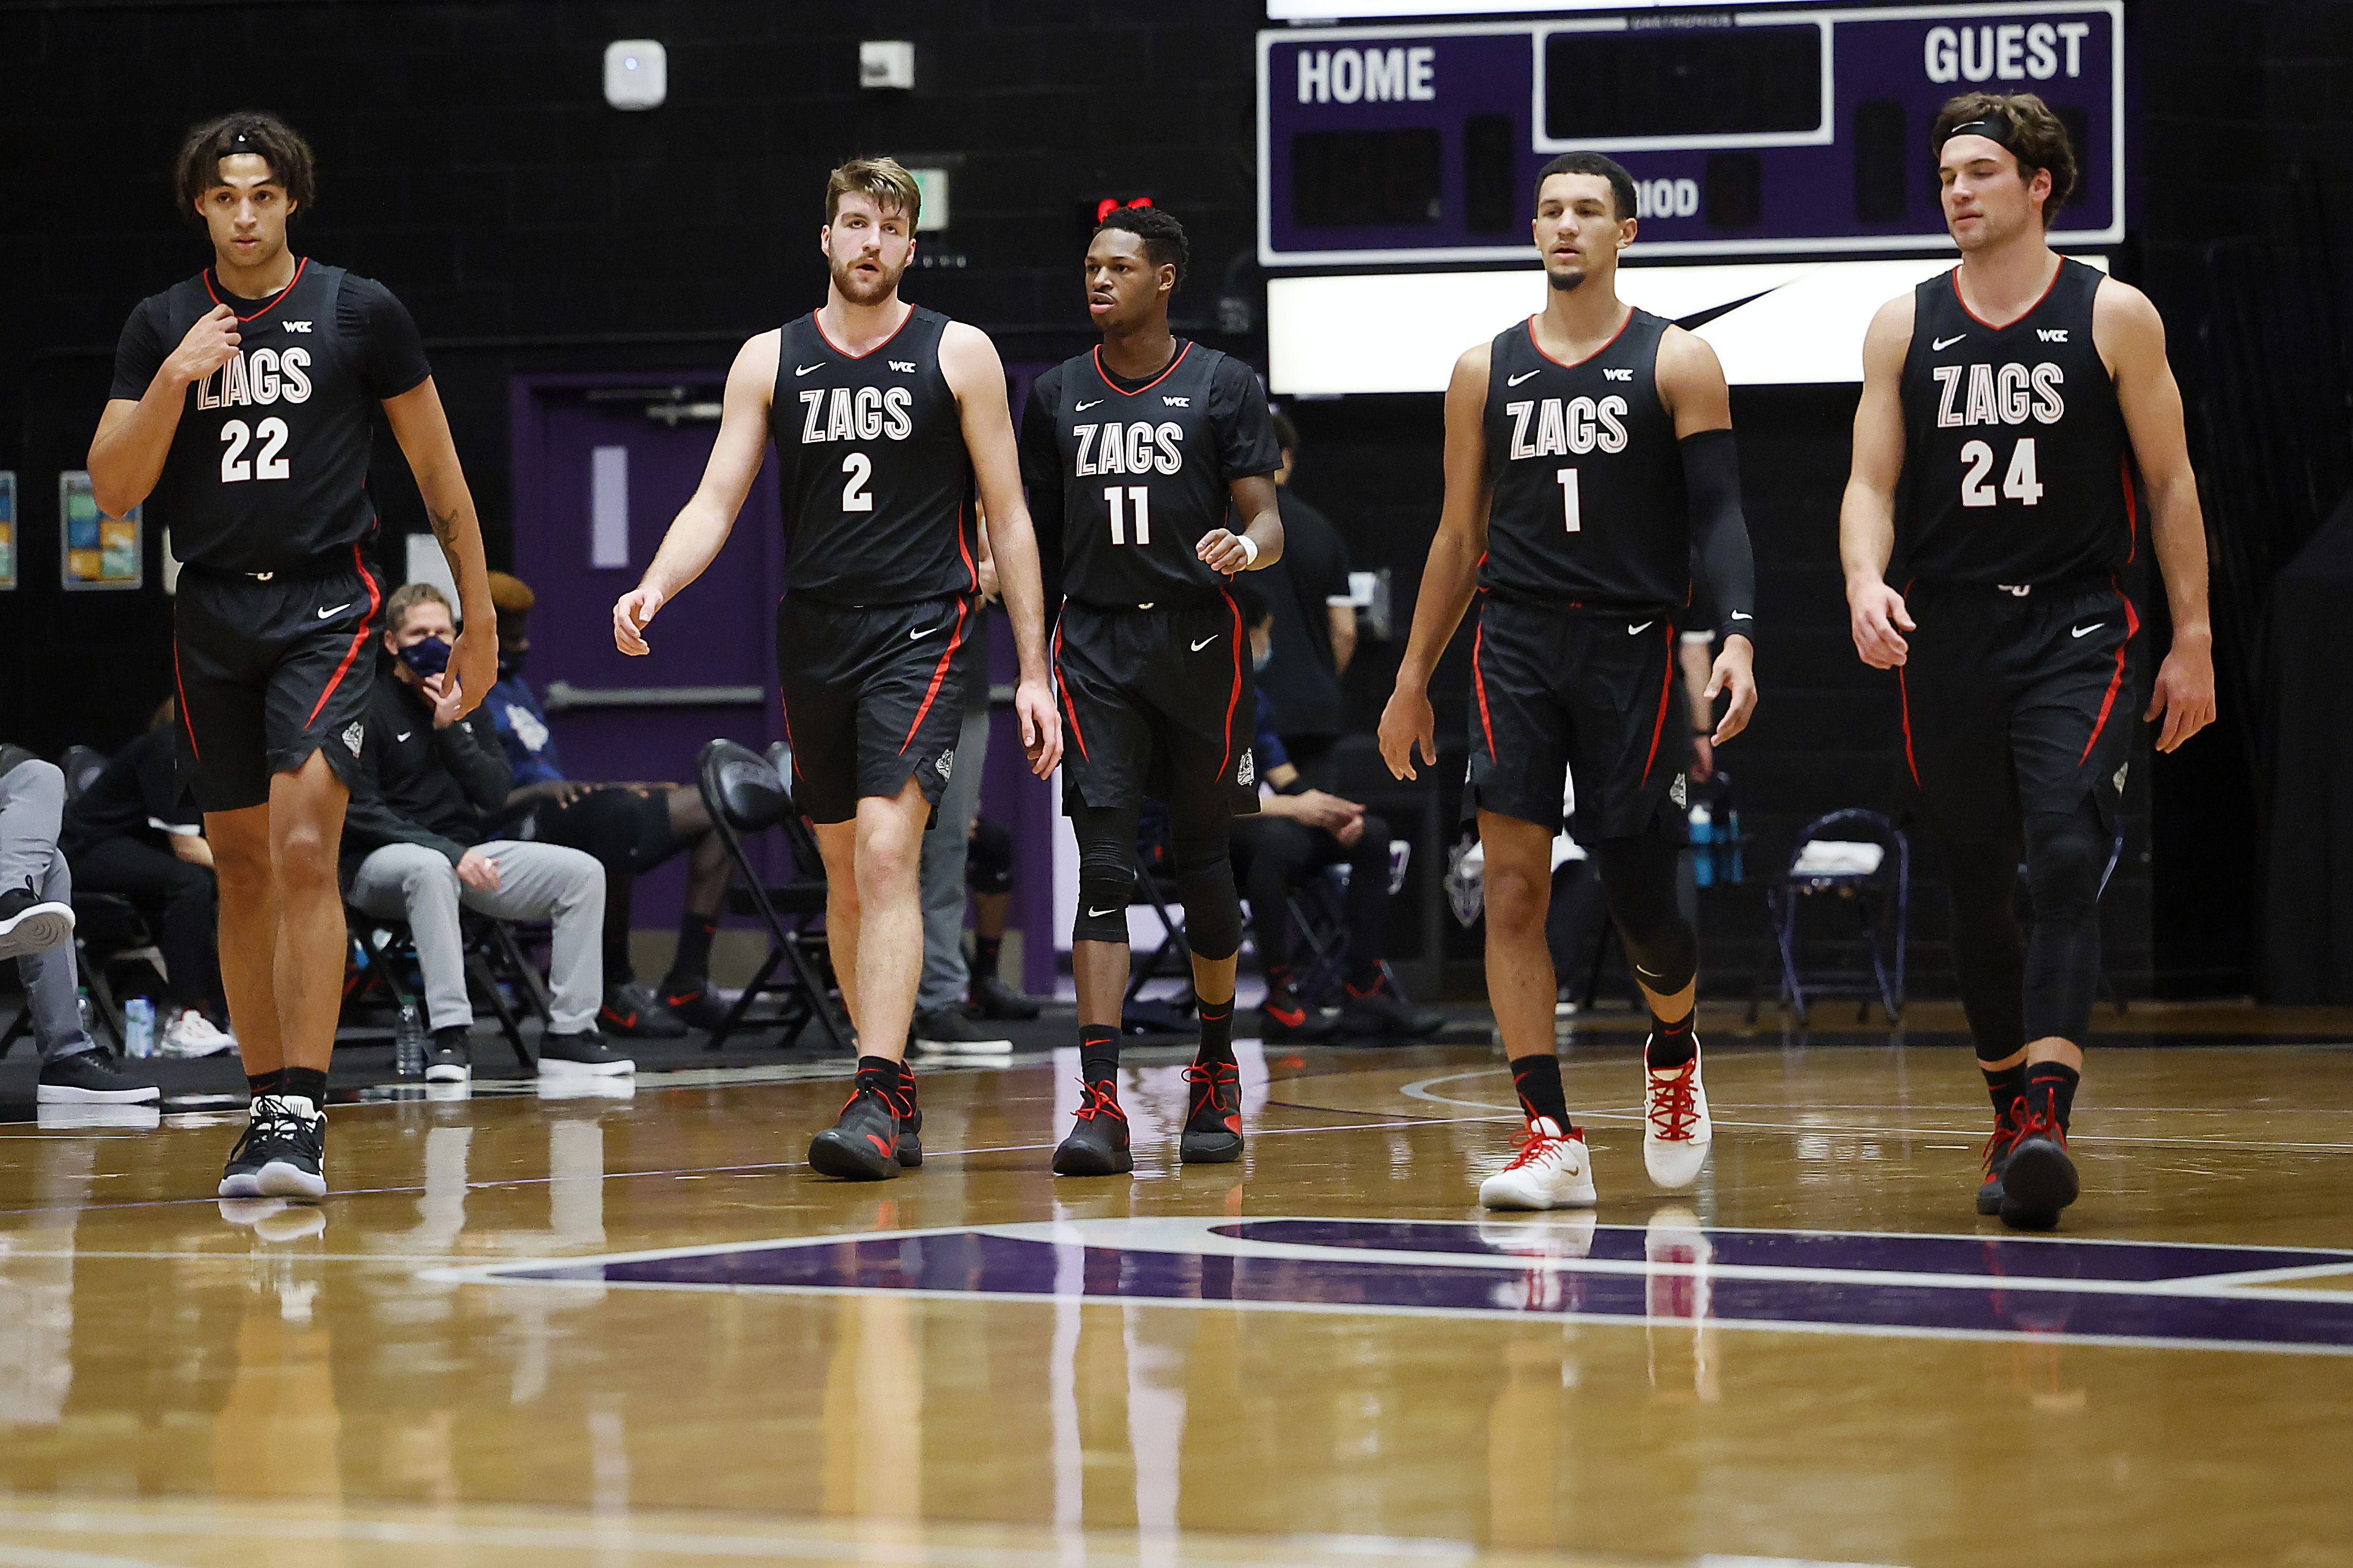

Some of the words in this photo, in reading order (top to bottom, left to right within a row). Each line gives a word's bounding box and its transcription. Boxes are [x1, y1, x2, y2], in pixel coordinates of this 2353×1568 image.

[1297, 47, 1436, 104] HOME
[1924, 22, 2089, 84] GUEST
[282, 321, 312, 333] WCC
[2036, 328, 2068, 343] WCC
[888, 361, 917, 373] WCC
[1603, 368, 1633, 381] WCC
[1933, 362, 2064, 428] ZAGS
[799, 386, 912, 444] ZAGS
[1162, 395, 1190, 408] WCC
[1506, 395, 1628, 460] ZAGS
[220, 417, 290, 483] 22
[1073, 421, 1183, 477] ZAGS
[1961, 438, 2043, 506] 24
[842, 452, 873, 511] 2
[1557, 468, 1581, 532] 1
[1104, 486, 1150, 545] 11
